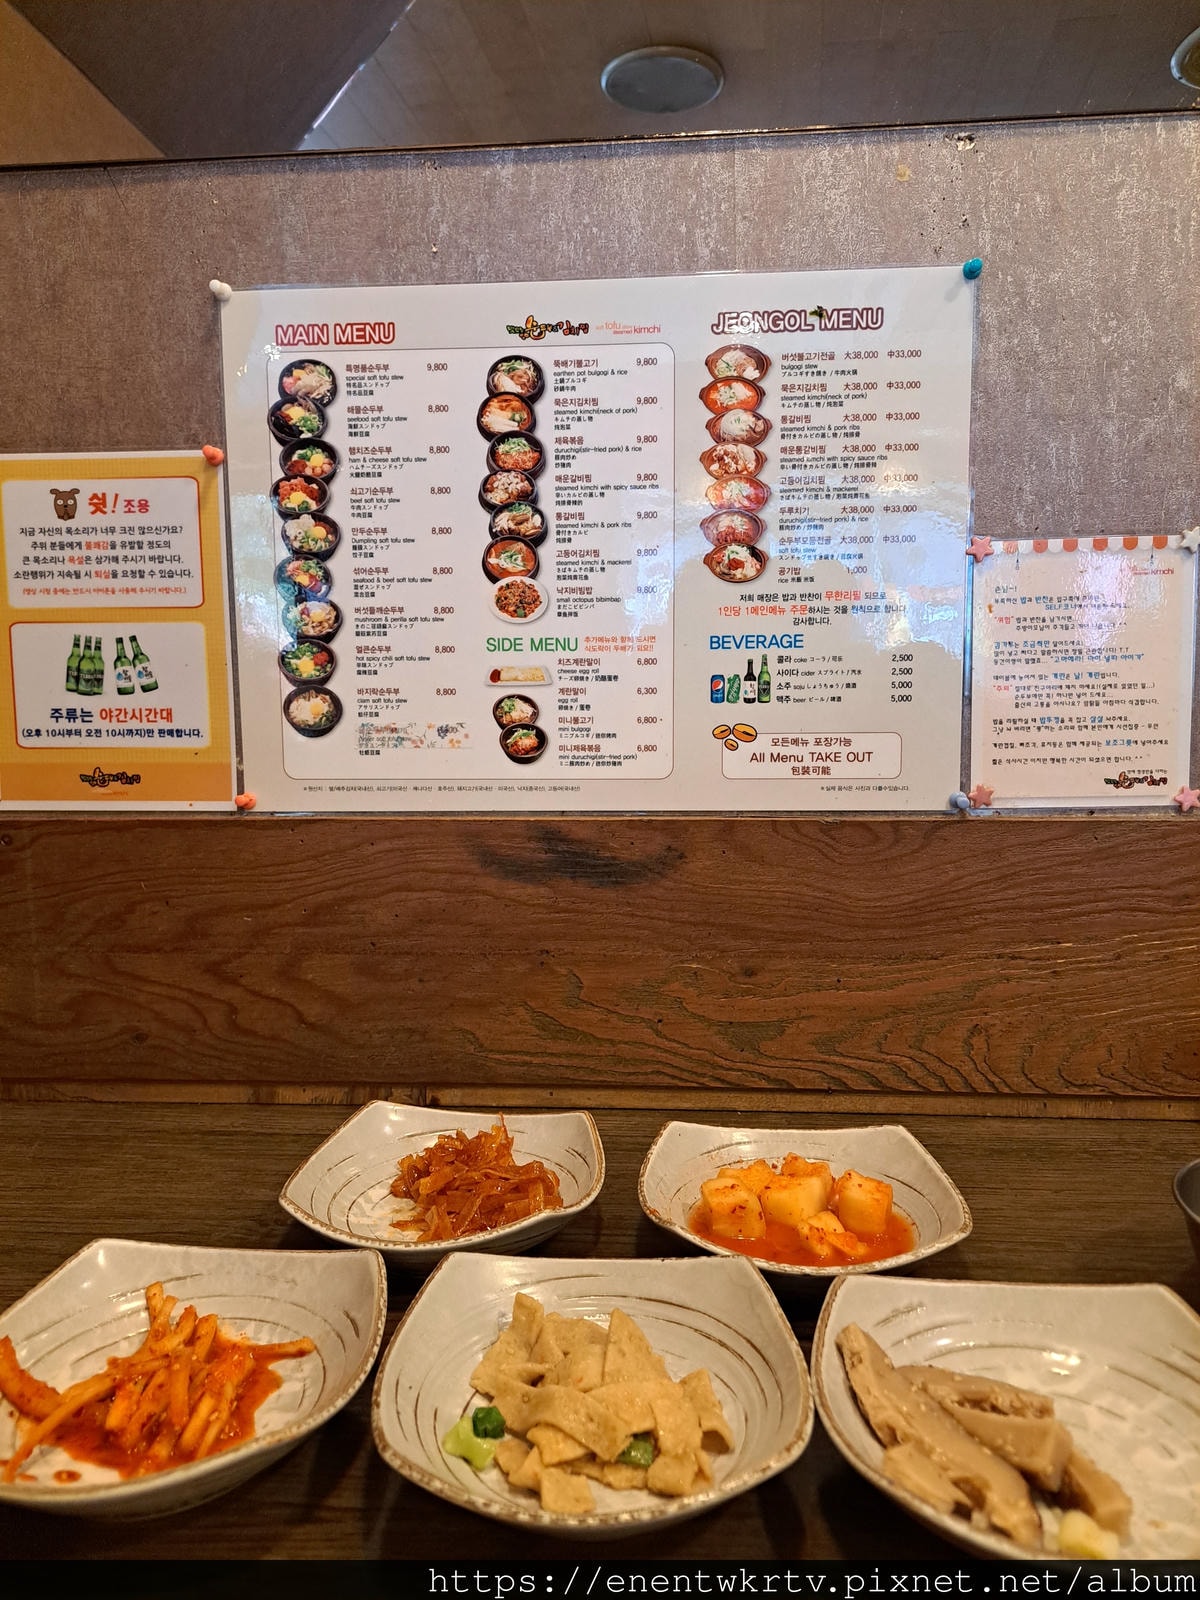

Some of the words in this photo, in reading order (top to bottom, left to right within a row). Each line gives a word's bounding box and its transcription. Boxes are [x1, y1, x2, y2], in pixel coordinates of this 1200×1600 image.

[712, 309, 814, 335] JEONGOL
[820, 308, 884, 331] MENU
[275, 324, 329, 346] MAIN
[334, 322, 395, 344] MENU
[633, 324, 660, 334] kimchi
[782, 352, 835, 361] 버섯불고기전골
[844, 351, 878, 360] 大38,000
[888, 350, 922, 359] 中33,000
[427, 363, 447, 371] 9,800
[553, 359, 598, 368] 뚝배기불고기
[636, 358, 657, 366] 9,800
[781, 384, 827, 393] 묵은지김치찜
[887, 381, 921, 390] 中33,000
[636, 397, 657, 405] 9,800
[428, 405, 448, 413] 8,800
[781, 415, 811, 424] 통갈비찜
[843, 414, 877, 423] 大38,000
[555, 437, 584, 445] 제육볶음
[637, 435, 657, 443] 9,800
[429, 446, 450, 454] 8,800
[780, 446, 826, 455] 매운통갈비찜
[842, 444, 876, 453] 大38,000
[885, 443, 919, 452] 中33,000
[555, 474, 591, 483] 매운갈비찜
[431, 487, 450, 495] 8,800
[124, 499, 150, 513] 조용
[556, 512, 584, 520] 통갈비찜
[637, 511, 657, 519] 9,800
[20, 528, 35, 536] 지금
[38, 527, 62, 536] 자신의
[65, 527, 97, 536] 목소리가
[101, 527, 116, 535] 너무
[119, 527, 135, 535] 크진
[138, 526, 183, 534] 않으신가요?
[432, 527, 452, 535] 8,800
[31, 542, 46, 550] 주위
[50, 542, 83, 550] 분들에게
[85, 541, 117, 550] 불쾌감을
[120, 541, 144, 549] 유발할
[147, 540, 171, 549] 정도의
[556, 550, 599, 558] 고등어김치찜
[23, 556, 30, 565] 큰
[33, 556, 65, 565] 목소리나
[68, 556, 92, 565] 욕설은
[95, 555, 119, 565] 삼가해
[122, 555, 146, 564] 주시기
[149, 555, 184, 564] 바랍니다.
[14, 571, 54, 579] 소란행위가
[84, 571, 92, 579] 시
[95, 570, 119, 579] 퇴실을
[122, 570, 145, 579] 요청할
[148, 570, 156, 578] 수
[159, 569, 194, 578] 있습니다.
[778, 567, 800, 576] 공기밥
[757, 593, 779, 601] 매장은
[800, 592, 822, 600] 반찬이
[825, 591, 861, 600] 무한리필
[865, 591, 886, 600] 되므로
[719, 607, 741, 616] 1인당
[746, 606, 785, 616] 1메인메뉴
[790, 605, 830, 615] 주문하시는
[834, 605, 848, 614] 것을
[851, 605, 881, 614] 원칙으로
[793, 617, 832, 625] 감사합니다.
[486, 638, 523, 652] SIDE
[530, 637, 578, 652] MENU
[710, 634, 804, 649] BEVERAGE
[558, 658, 600, 666] 치즈계란말이
[892, 654, 913, 662] 2,500
[777, 669, 799, 677] 사이다
[892, 668, 913, 676] 2,500
[777, 682, 791, 690] 소주
[891, 681, 912, 689] 5,000
[777, 696, 791, 704] 맥주
[891, 695, 912, 703] 5,000
[50, 708, 93, 723] 주류는
[99, 708, 173, 723] 야간시간대
[559, 716, 593, 724] 미니불고기
[637, 716, 657, 724] 6,800
[22, 729, 42, 738] (오후
[46, 729, 82, 738] 10시부터
[85, 729, 102, 738] 오전
[106, 729, 154, 738] 10시까지)만
[158, 729, 203, 738] 판매합니다.
[771, 738, 809, 747] 모든메뉴
[813, 737, 852, 746] 포장가능
[750, 753, 765, 763] All
[770, 753, 804, 763] Menu
[809, 752, 842, 762] TAKE
[847, 752, 873, 762] OUT
[791, 766, 831, 776] 包裝可能
